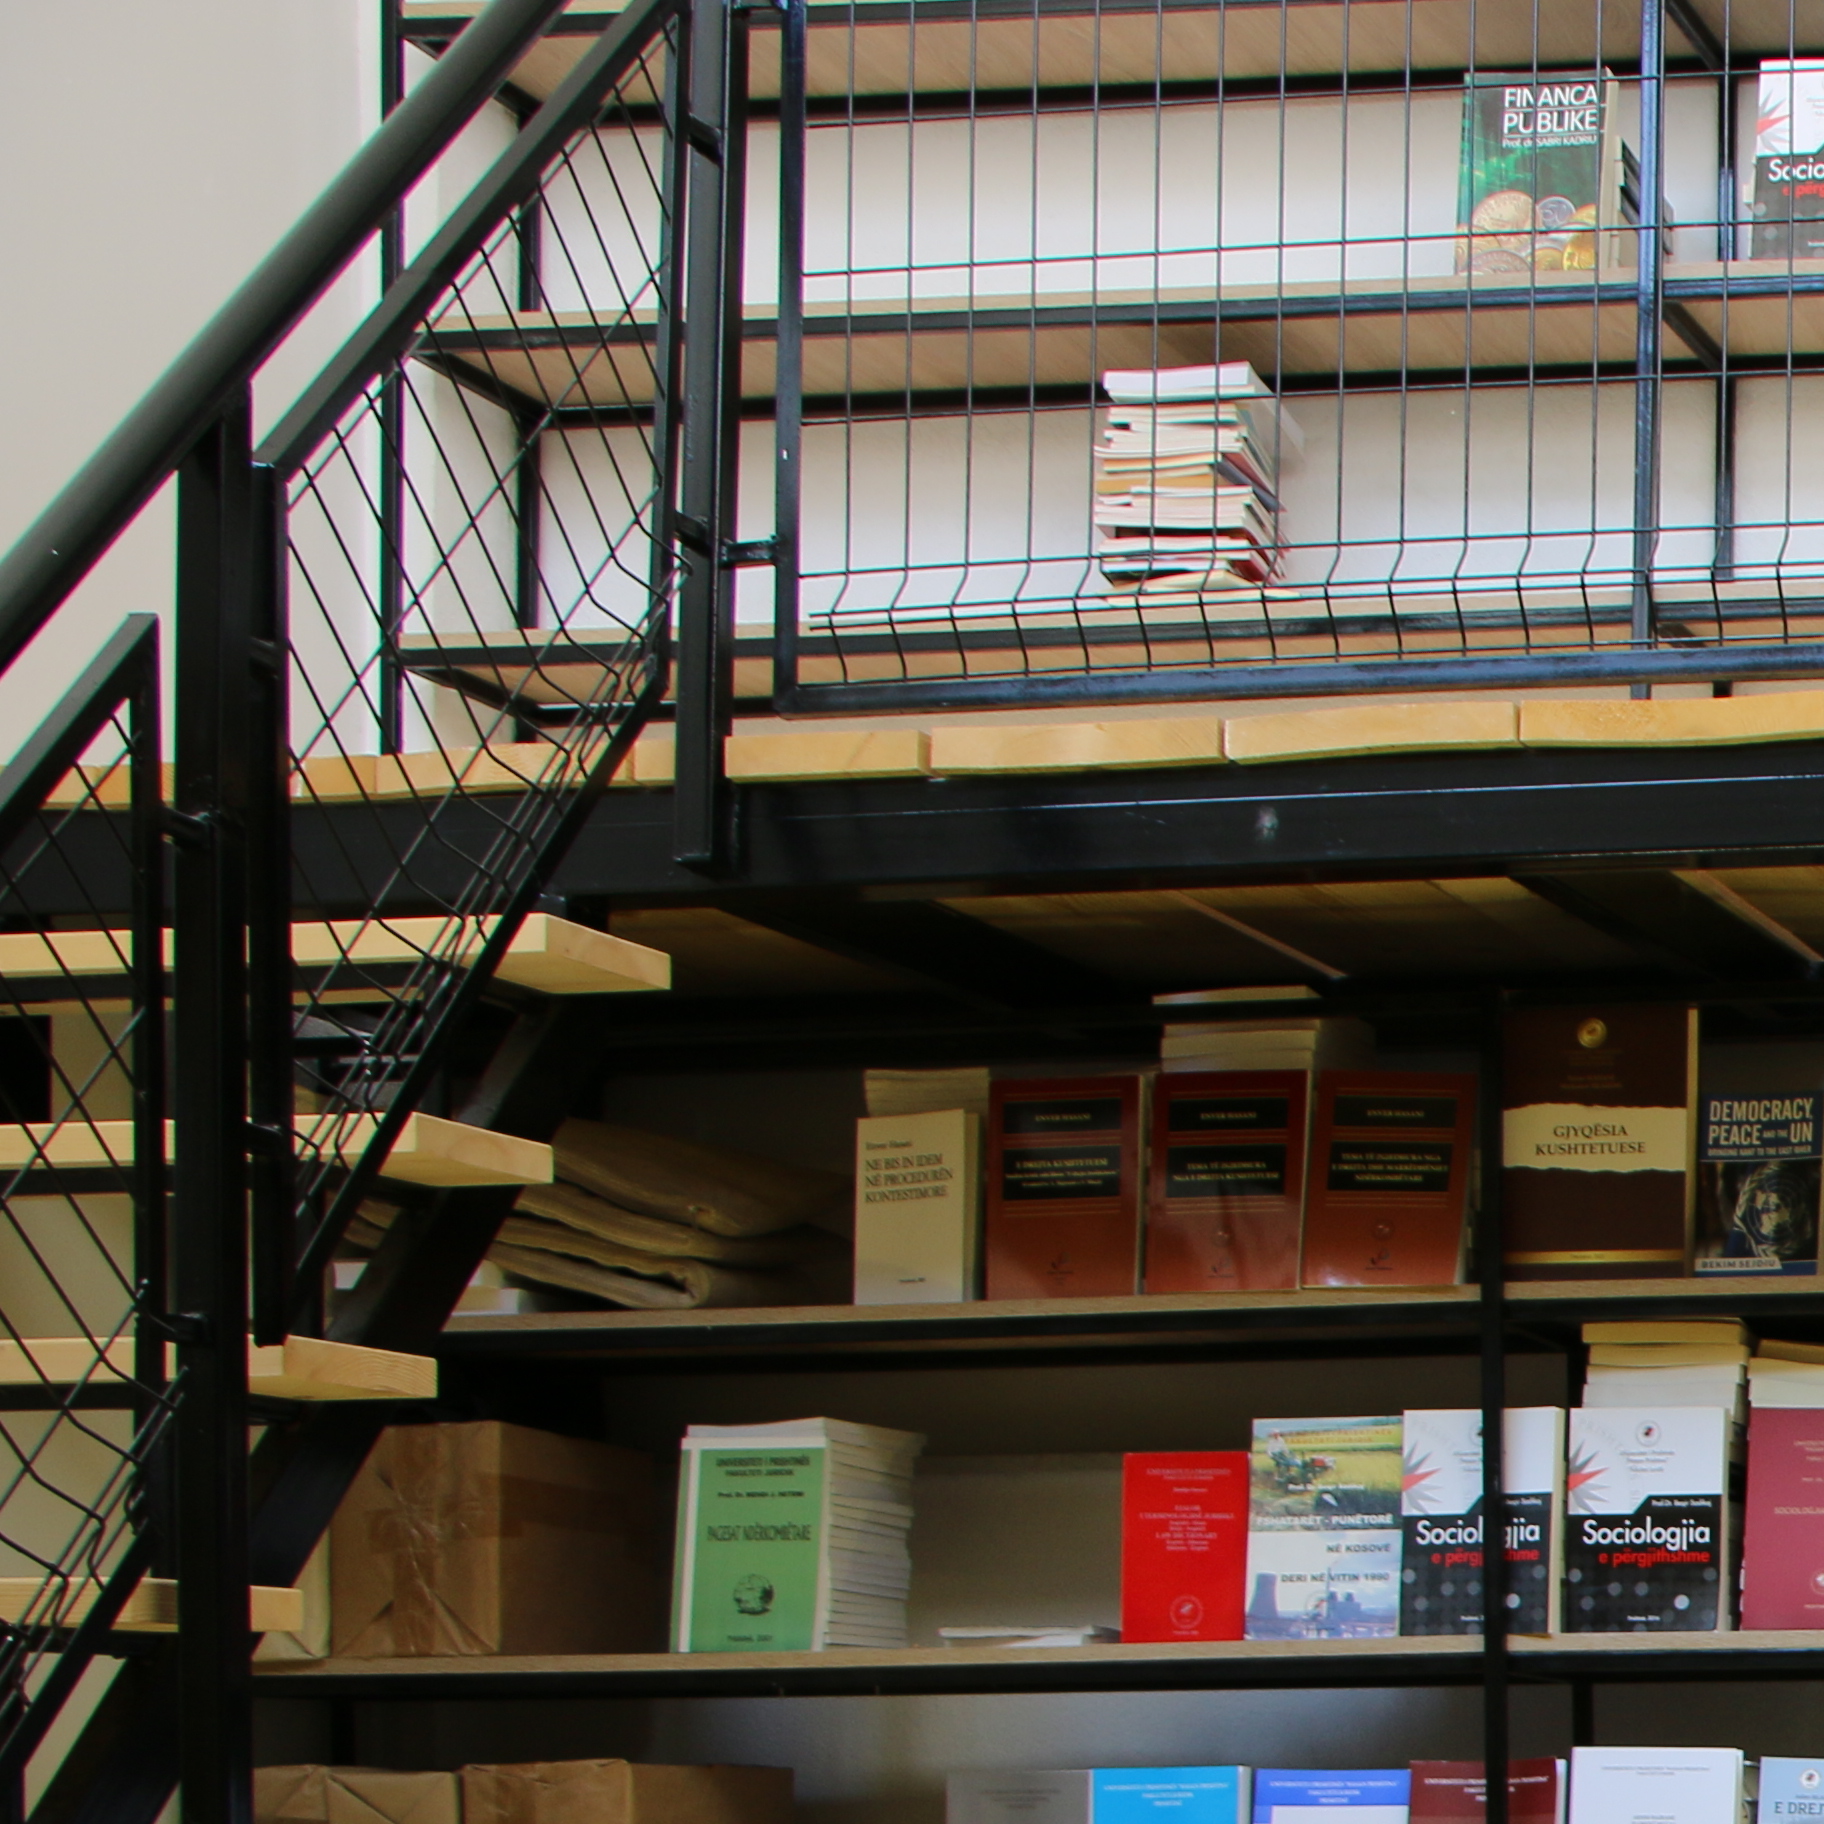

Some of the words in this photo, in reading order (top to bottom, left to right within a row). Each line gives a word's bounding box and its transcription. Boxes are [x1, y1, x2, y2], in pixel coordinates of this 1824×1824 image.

[1504, 84, 1598, 108] FINANCA
[1503, 109, 1598, 135] PUBLIKE
[1709, 1097, 1813, 1123] DEMOCRACY,
[1553, 1122, 1629, 1139] GJYQËSIA
[1708, 1123, 1759, 1145] PEACE
[1789, 1121, 1812, 1143] UN
[1535, 1139, 1646, 1156] KUSHTETUESE
[915, 1154, 942, 1169] IDEM
[1416, 1519, 1540, 1549] Sociolgjia
[1582, 1516, 1711, 1549] Sociologjia
[1281, 1571, 1305, 1583] DERI
[1328, 1571, 1361, 1583] VITIN
